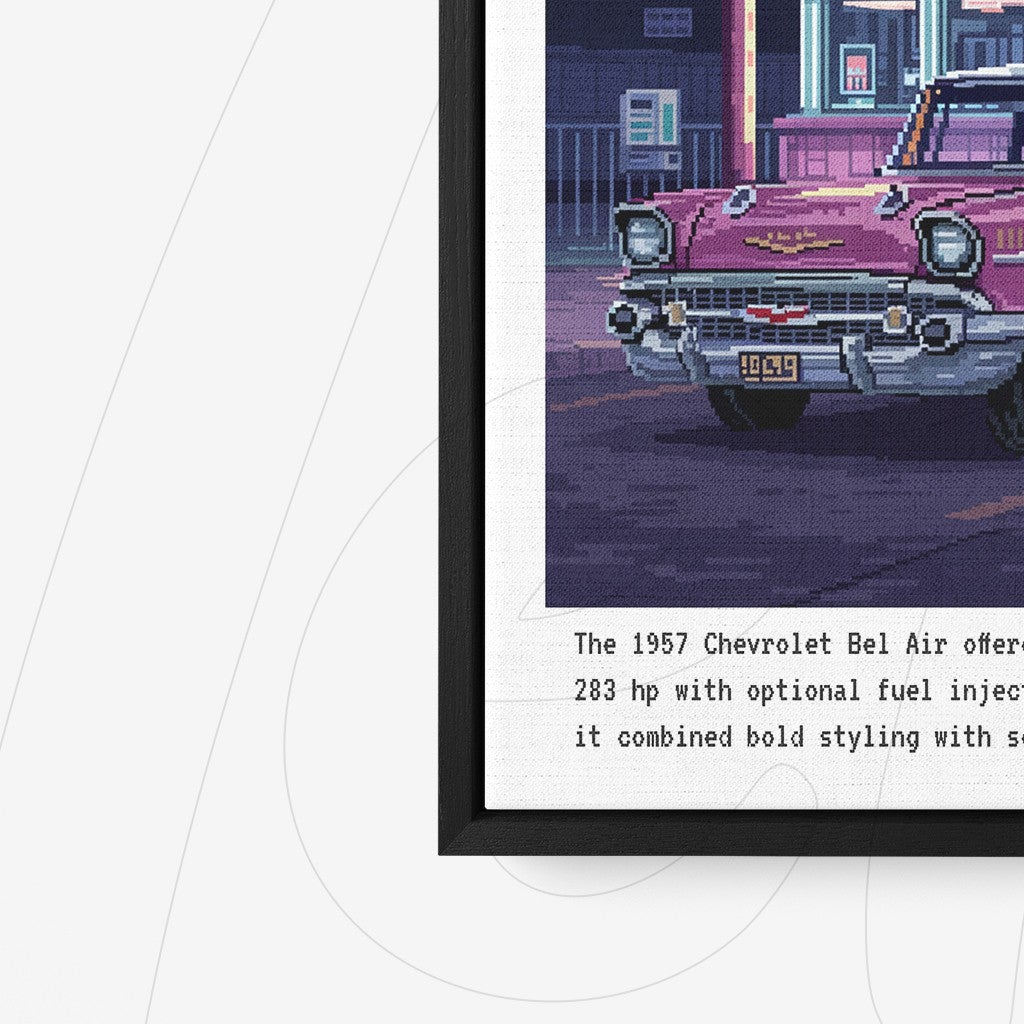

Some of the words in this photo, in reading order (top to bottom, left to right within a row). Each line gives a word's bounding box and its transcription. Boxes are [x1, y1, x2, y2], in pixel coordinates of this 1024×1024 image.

[574, 632, 616, 655] The
[633, 632, 688, 655] 1957
[704, 632, 831, 655] Chevrolet
[848, 632, 889, 655] Bel
[906, 632, 948, 655] Air
[574, 678, 616, 701] 283
[631, 678, 660, 707] hp
[675, 678, 732, 701] with
[747, 678, 860, 707] optional
[878, 678, 932, 701] fuel
[575, 724, 601, 748] it
[617, 724, 732, 748] combined
[747, 724, 804, 748] bold
[820, 724, 920, 754] styling
[934, 724, 991, 748] with
